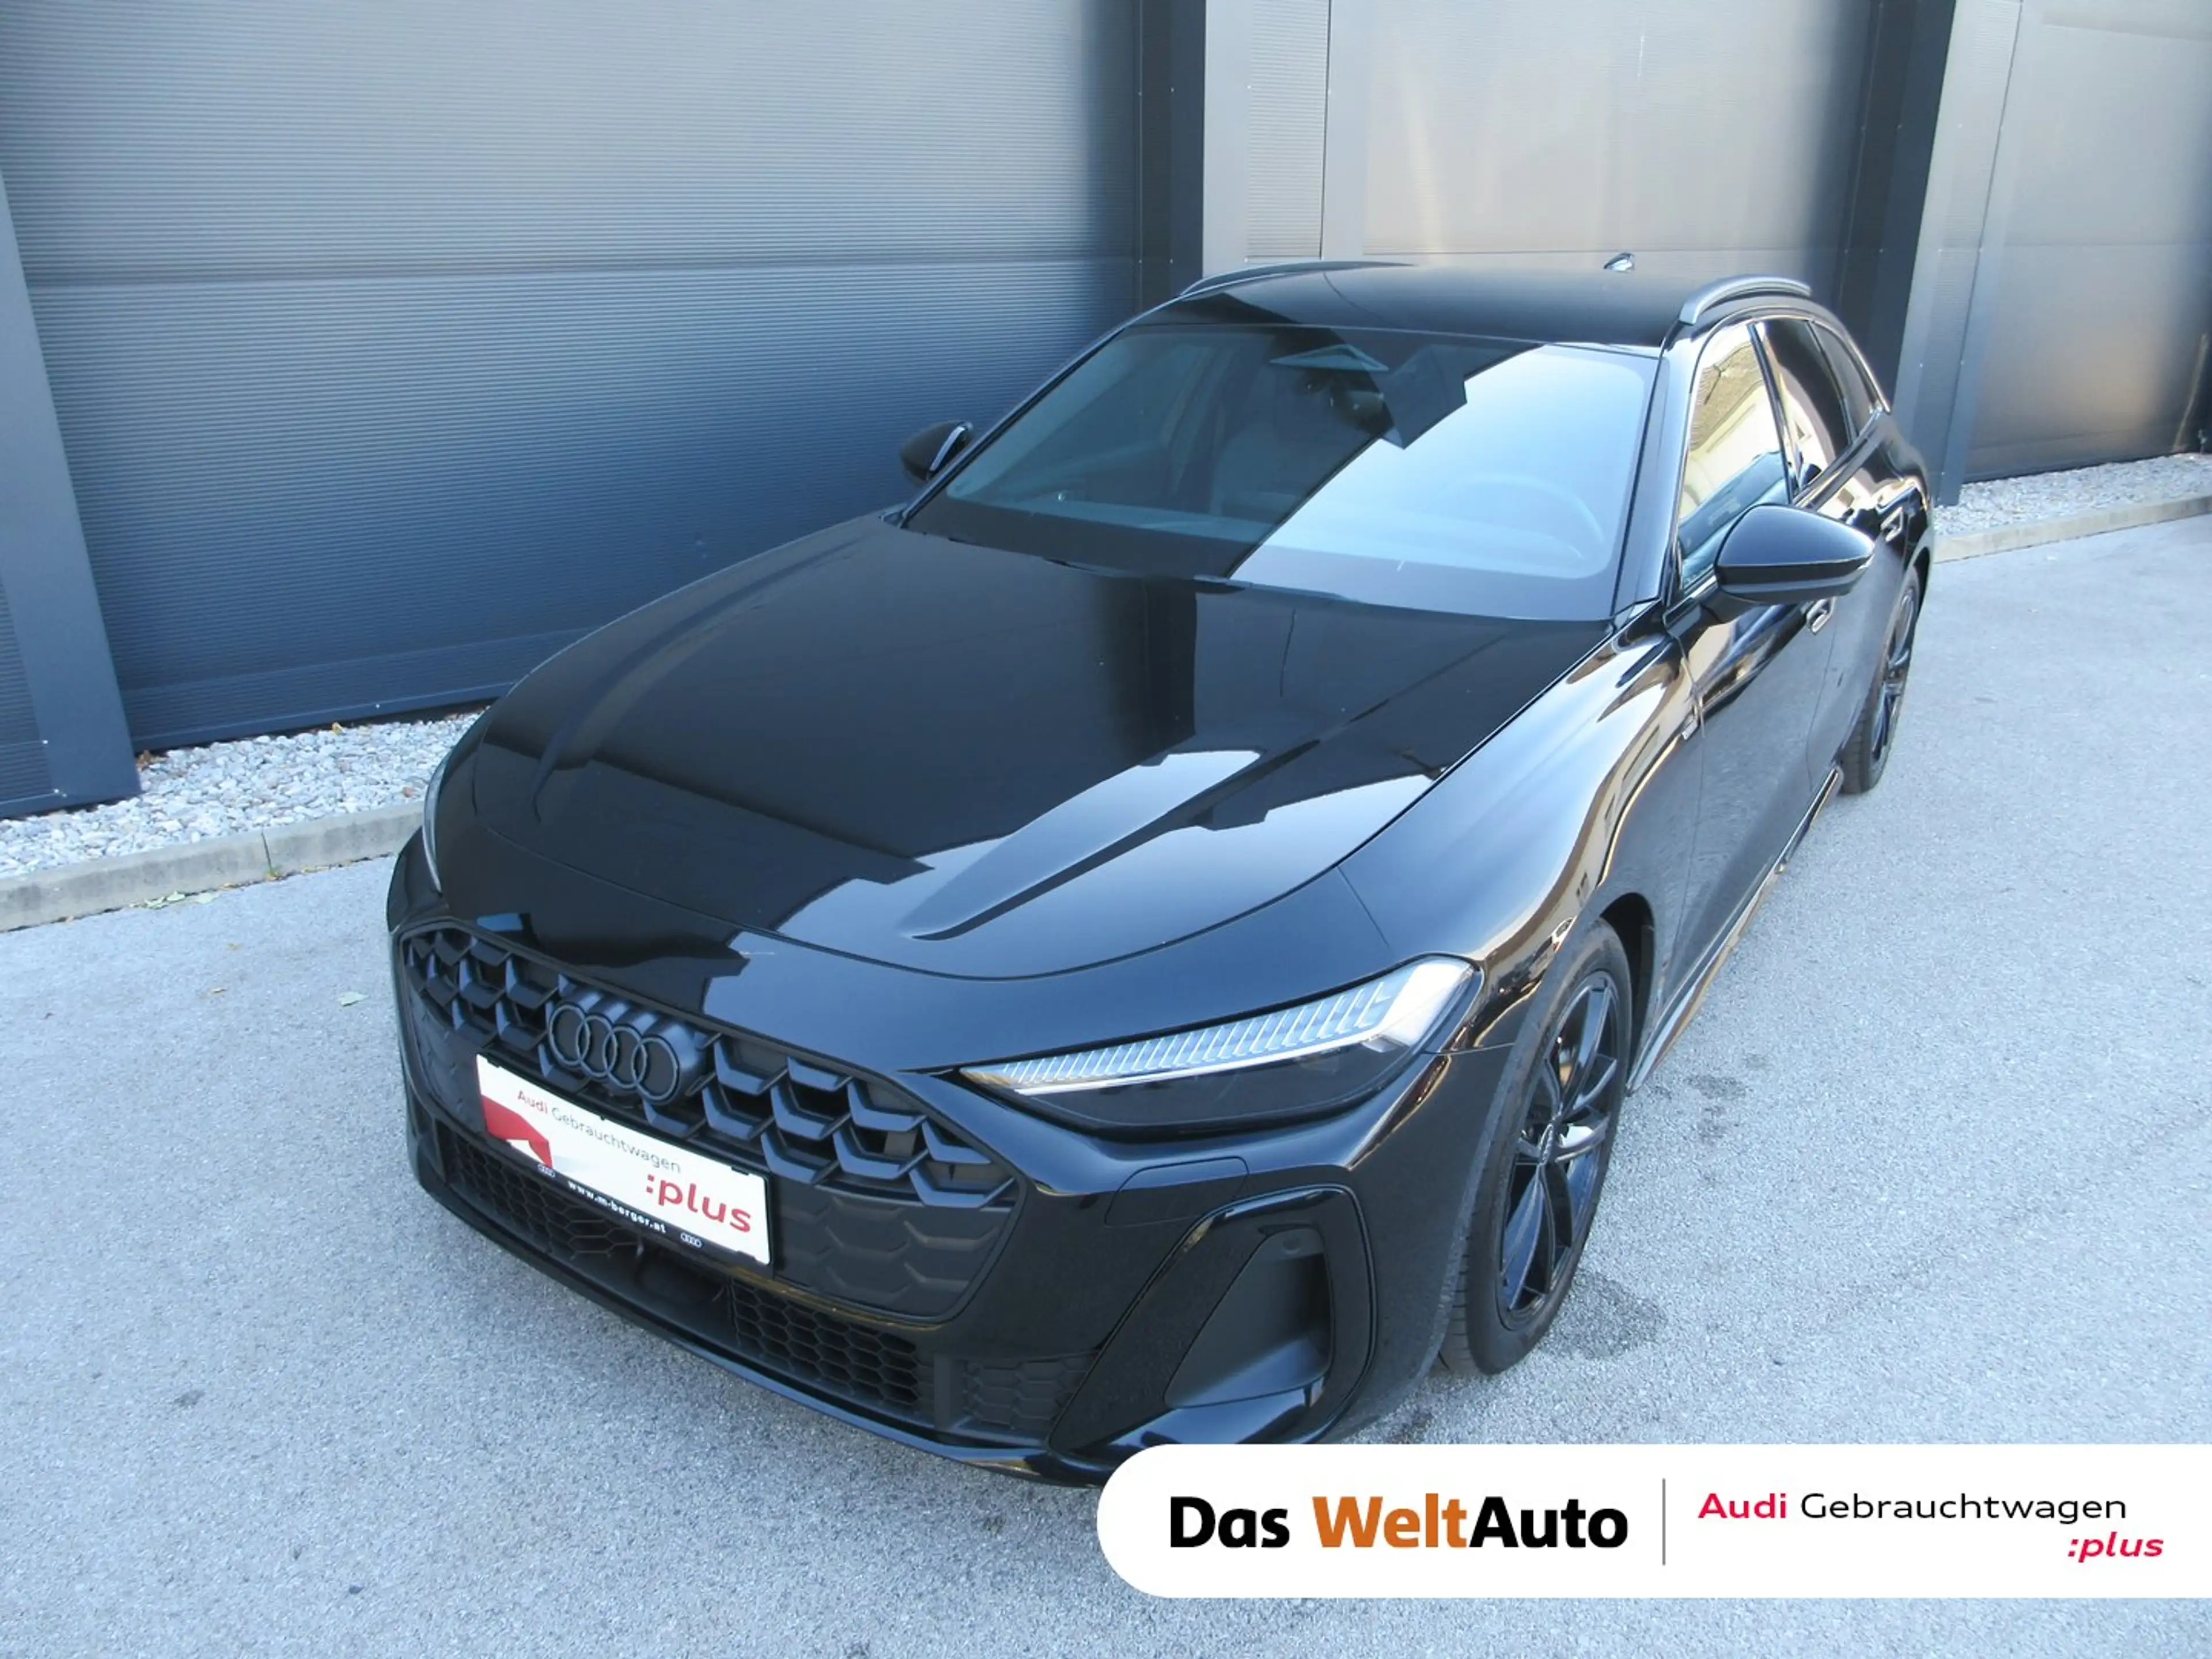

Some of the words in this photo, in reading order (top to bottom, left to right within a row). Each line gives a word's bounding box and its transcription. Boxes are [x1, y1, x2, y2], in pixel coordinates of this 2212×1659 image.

[518, 1090, 548, 1113] Audi
[551, 1107, 681, 1173] Gebrauchtwagen
[646, 1174, 752, 1233] :plus
